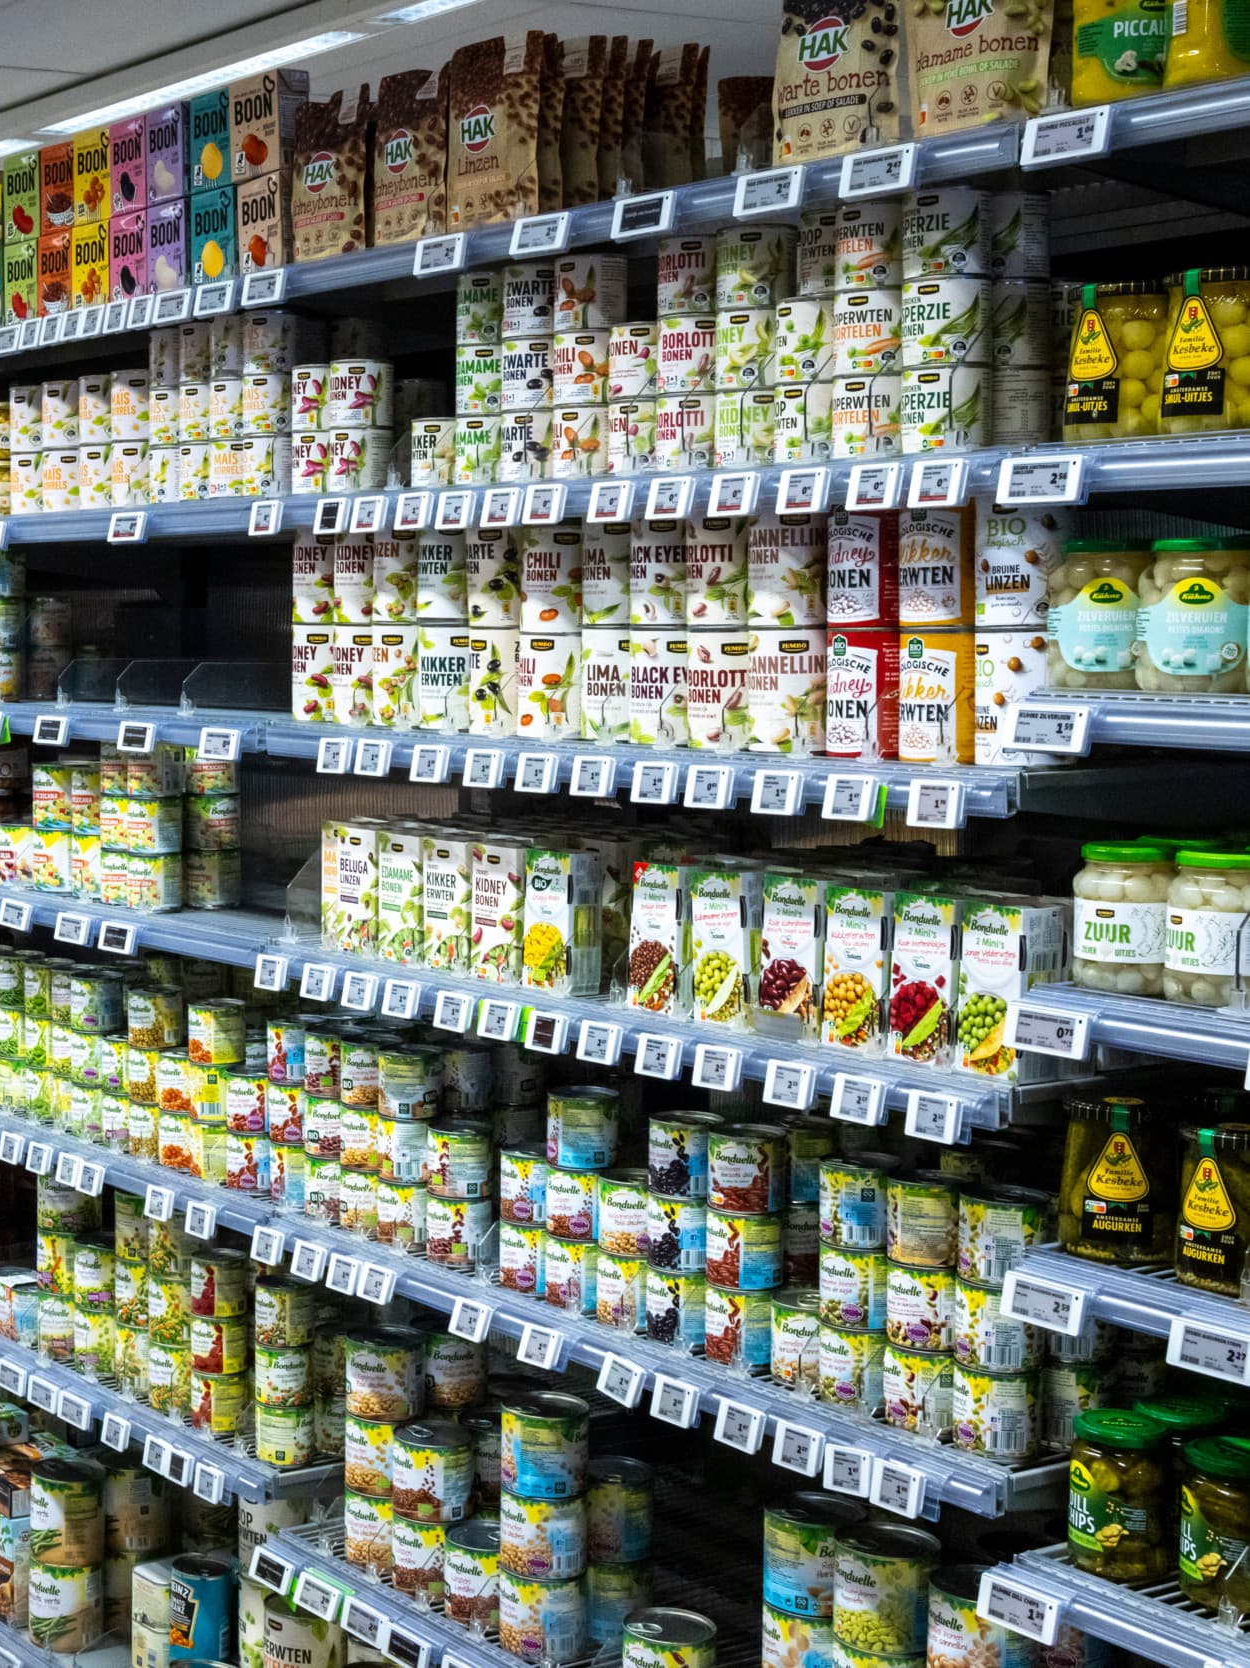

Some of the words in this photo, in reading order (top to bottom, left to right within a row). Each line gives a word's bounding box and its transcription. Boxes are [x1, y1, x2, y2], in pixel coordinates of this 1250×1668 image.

[946, 0, 993, 28] HAK
[799, 26, 849, 61] HAK
[979, 35, 1039, 54] bonen
[827, 70, 891, 93] bonen
[235, 92, 274, 126] BOON
[804, 104, 811, 112] IN
[811, 101, 825, 112] SOEP
[827, 99, 835, 108] OF
[836, 96, 859, 106] SALADE
[194, 109, 228, 140] BOON
[461, 115, 495, 143] HAK
[150, 124, 178, 153] BOON
[112, 136, 142, 164] BOON
[385, 139, 413, 164] HAK
[78, 146, 108, 175] BOON
[457, 153, 499, 176] Linzen
[44, 160, 74, 186] BOON
[304, 161, 334, 184] HAK
[7, 169, 35, 196] BOON
[242, 193, 276, 226] BOON
[195, 203, 228, 236] BOON
[151, 218, 180, 248] BOON
[114, 228, 143, 256] BOON
[76, 240, 106, 266] BOON
[7, 257, 34, 282] BOON
[41, 250, 68, 280] BOON
[506, 280, 554, 296] ZWARTE
[506, 298, 534, 308] BONEN
[1180, 335, 1206, 343] Familie
[662, 349, 692, 361] BONEN
[1173, 344, 1215, 356] Kesbeke
[503, 353, 548, 369] ZWARTE
[1074, 354, 1110, 365] Kesbeke
[503, 369, 527, 380] BONEN
[1165, 392, 1213, 405] SMUL-UITJES
[719, 406, 770, 423] KIDNEY
[214, 452, 238, 465] MAÏS
[988, 517, 1027, 537] BIO
[987, 536, 1027, 550] logisch
[526, 552, 561, 569] CHILI
[336, 562, 365, 574] BONEN
[992, 564, 1021, 574] BRUINE
[526, 569, 558, 582] BONEN
[985, 574, 1030, 591] LINZEN
[1092, 592, 1120, 600] Kühne
[1182, 593, 1211, 601] Kühne
[1078, 610, 1136, 622] ZILVERUIEN
[1166, 611, 1228, 623] ZILVERUIEN
[780, 642, 808, 650] JUMBO
[835, 642, 847, 650] BIO
[910, 644, 922, 652] BIO
[421, 656, 465, 672] KIKKER
[421, 673, 462, 686] ERWTEN
[587, 665, 620, 682] LIMA
[631, 666, 670, 683] BLACK
[587, 682, 626, 697] BONEN
[631, 685, 663, 699] BONEN
[688, 689, 721, 704] BONEN
[340, 857, 368, 874] BELUGA
[340, 873, 360, 886] LINZEN
[382, 865, 413, 882] EDAMAME
[426, 872, 456, 888] KIKKER
[382, 880, 402, 894] BONEN
[475, 877, 507, 896] KIDNEY
[535, 878, 546, 888] BIO
[640, 878, 669, 891] Bonduelle
[426, 887, 454, 901] ERWTEN
[475, 894, 498, 907] BONEN
[698, 888, 731, 900] Bonduelle
[772, 892, 806, 906] Bonduelle
[709, 903, 728, 911] Mini's
[782, 908, 802, 918] Mini's
[835, 903, 871, 919] Bonduelle
[904, 910, 942, 926] Bonduelle
[840, 920, 844, 928] 2
[845, 920, 867, 931] Mini's
[971, 918, 1009, 936] Bonduelle
[1084, 921, 1131, 944] ZUUR
[908, 927, 912, 935] 2
[915, 928, 937, 939] Mini's
[976, 937, 980, 945] 2
[982, 939, 1005, 949] Mini's
[1115, 949, 1136, 958] UITJES
[1182, 957, 1200, 967] UITJES
[307, 1132, 318, 1141] BIO
[715, 1151, 757, 1165] Bonduelle
[1105, 1168, 1134, 1176] Familie
[1096, 1175, 1144, 1187] Kesbeke
[607, 1198, 646, 1211] Bonduelle
[1193, 1194, 1220, 1205] Familie
[1187, 1201, 1229, 1218] Kesbeke
[1096, 1215, 1140, 1223] AMSTERDAMSE
[1092, 1220, 1142, 1233] AUGURKEN
[1185, 1241, 1222, 1254] AMSTERDAMSE
[1182, 1247, 1225, 1265] AUGURKEN
[434, 1351, 474, 1363] Bonduelle
